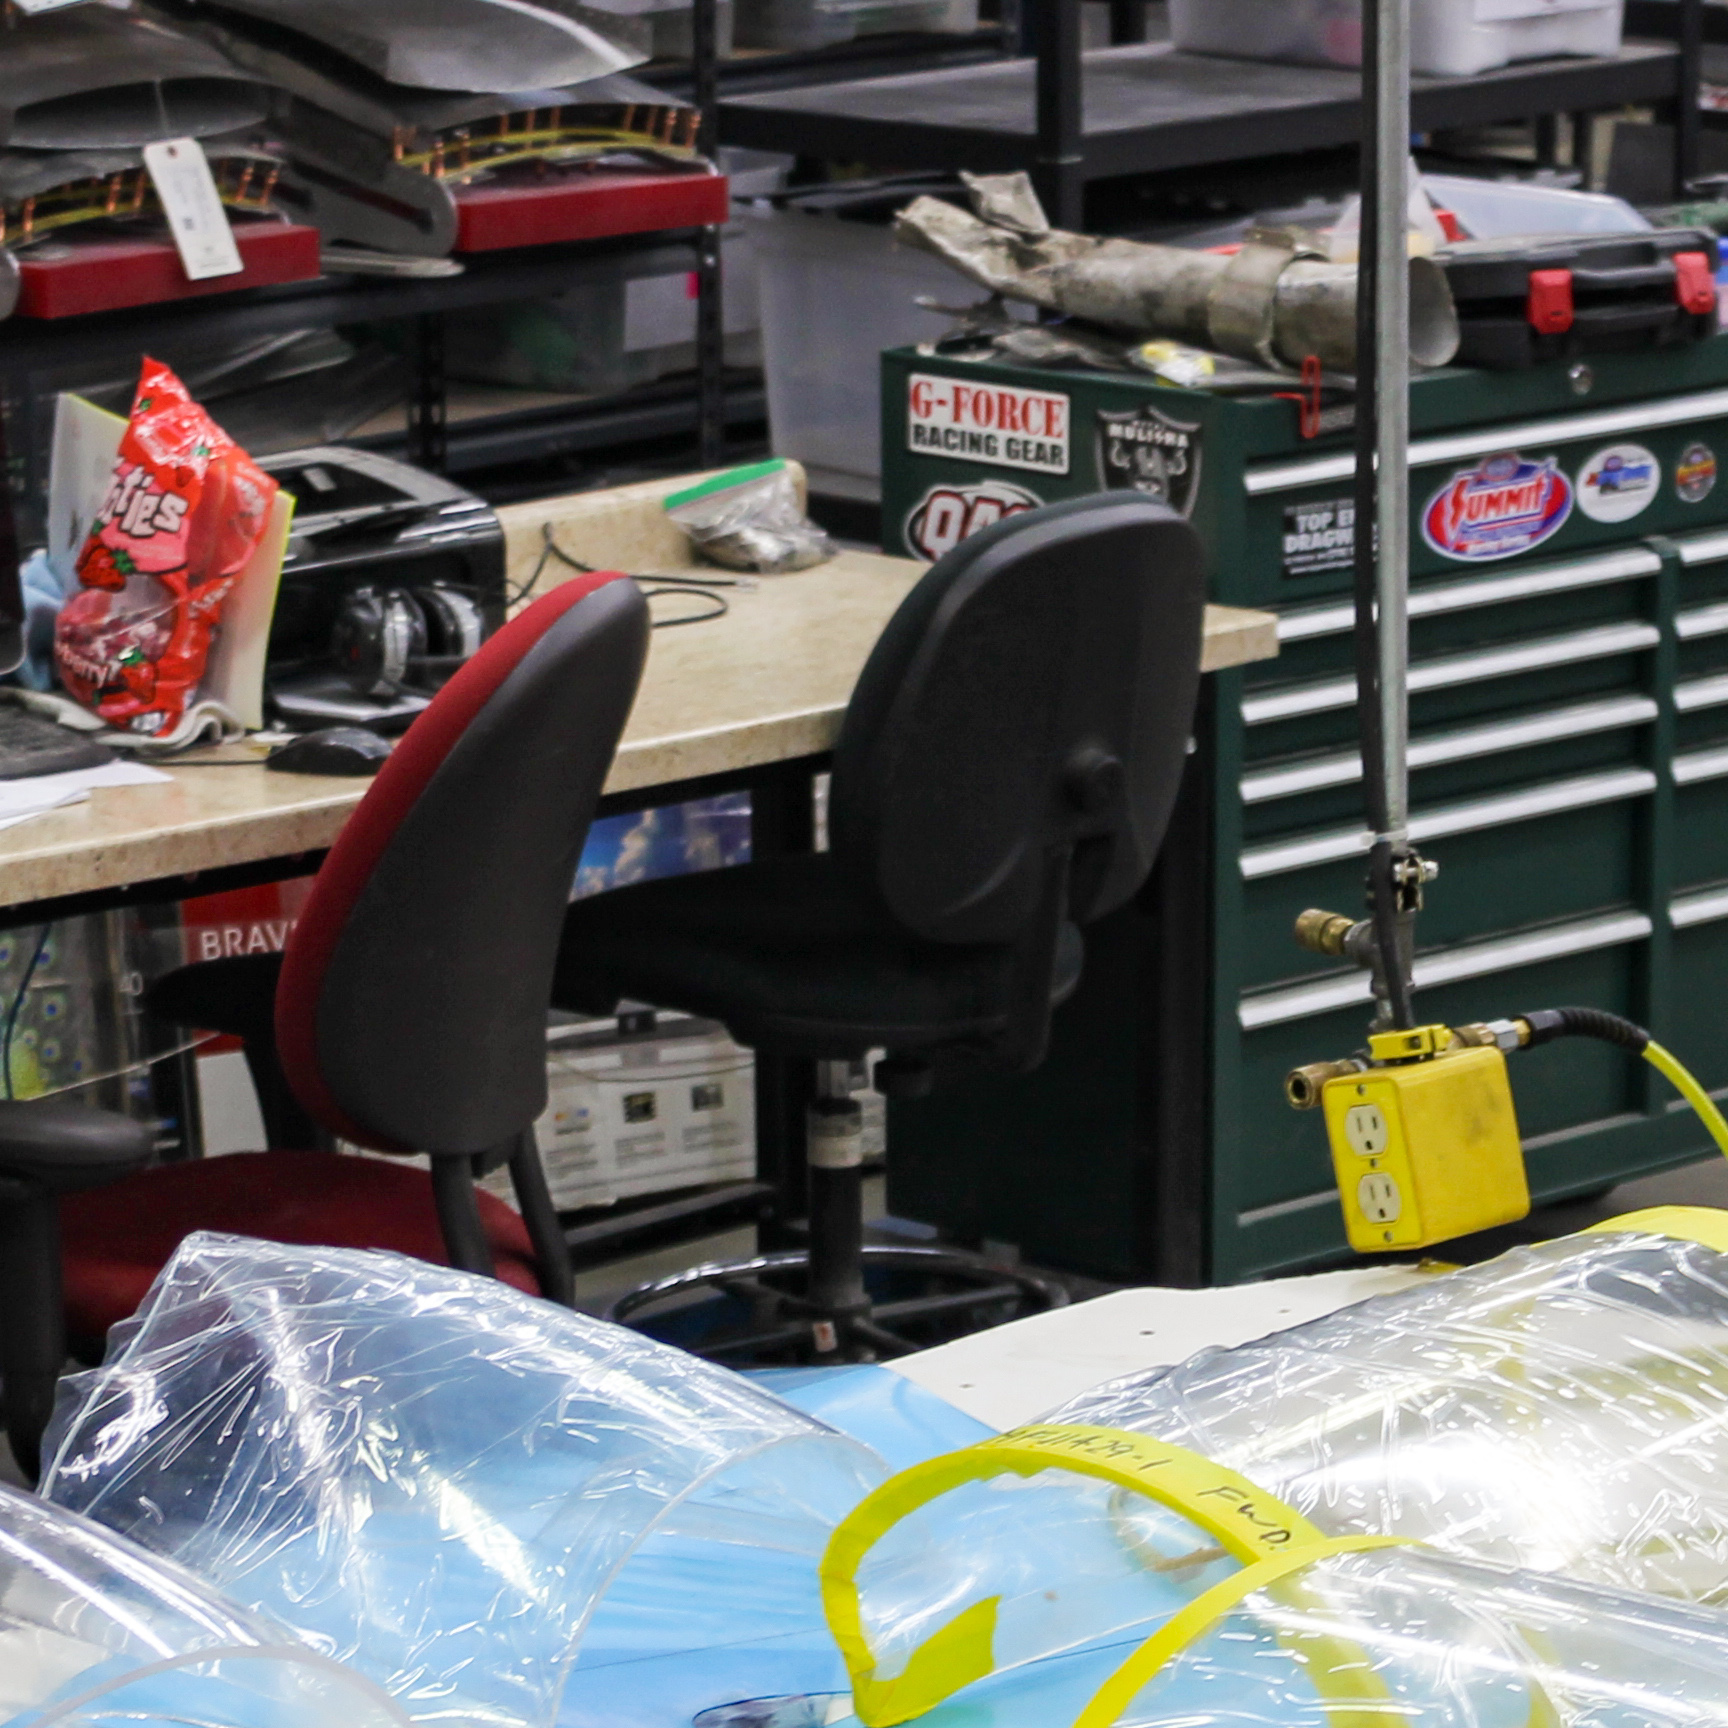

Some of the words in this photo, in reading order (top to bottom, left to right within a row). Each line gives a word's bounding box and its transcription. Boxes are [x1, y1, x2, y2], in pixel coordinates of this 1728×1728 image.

[909, 380, 1065, 438] G-FORCE
[913, 423, 999, 457] RACING
[1005, 436, 1065, 468] GEAR
[1296, 511, 1333, 534] TOP
[201, 920, 298, 961] BRAV
